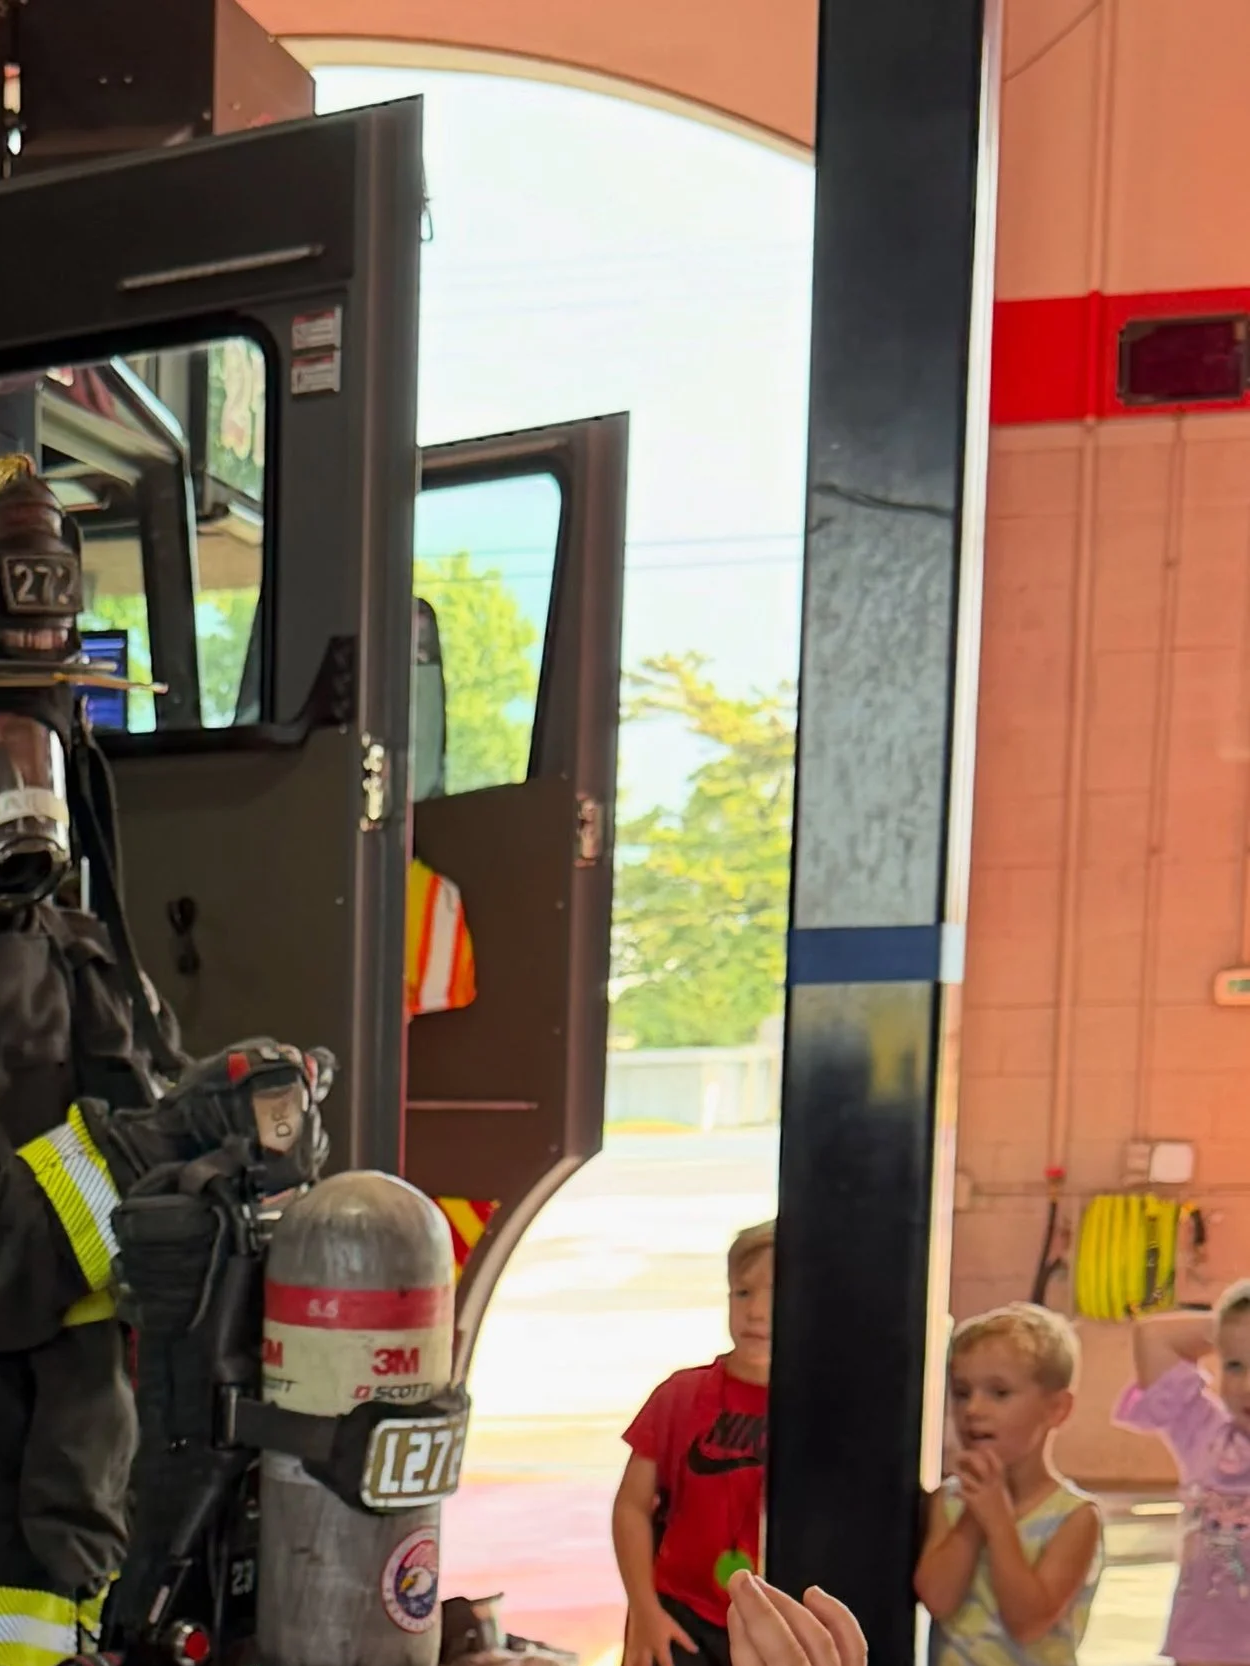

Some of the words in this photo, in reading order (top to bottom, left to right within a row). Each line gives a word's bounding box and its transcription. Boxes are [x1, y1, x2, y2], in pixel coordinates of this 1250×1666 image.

[371, 1347, 420, 1376] 3M
[374, 1383, 432, 1400] SCOTT
[705, 1410, 769, 1451] NIK
